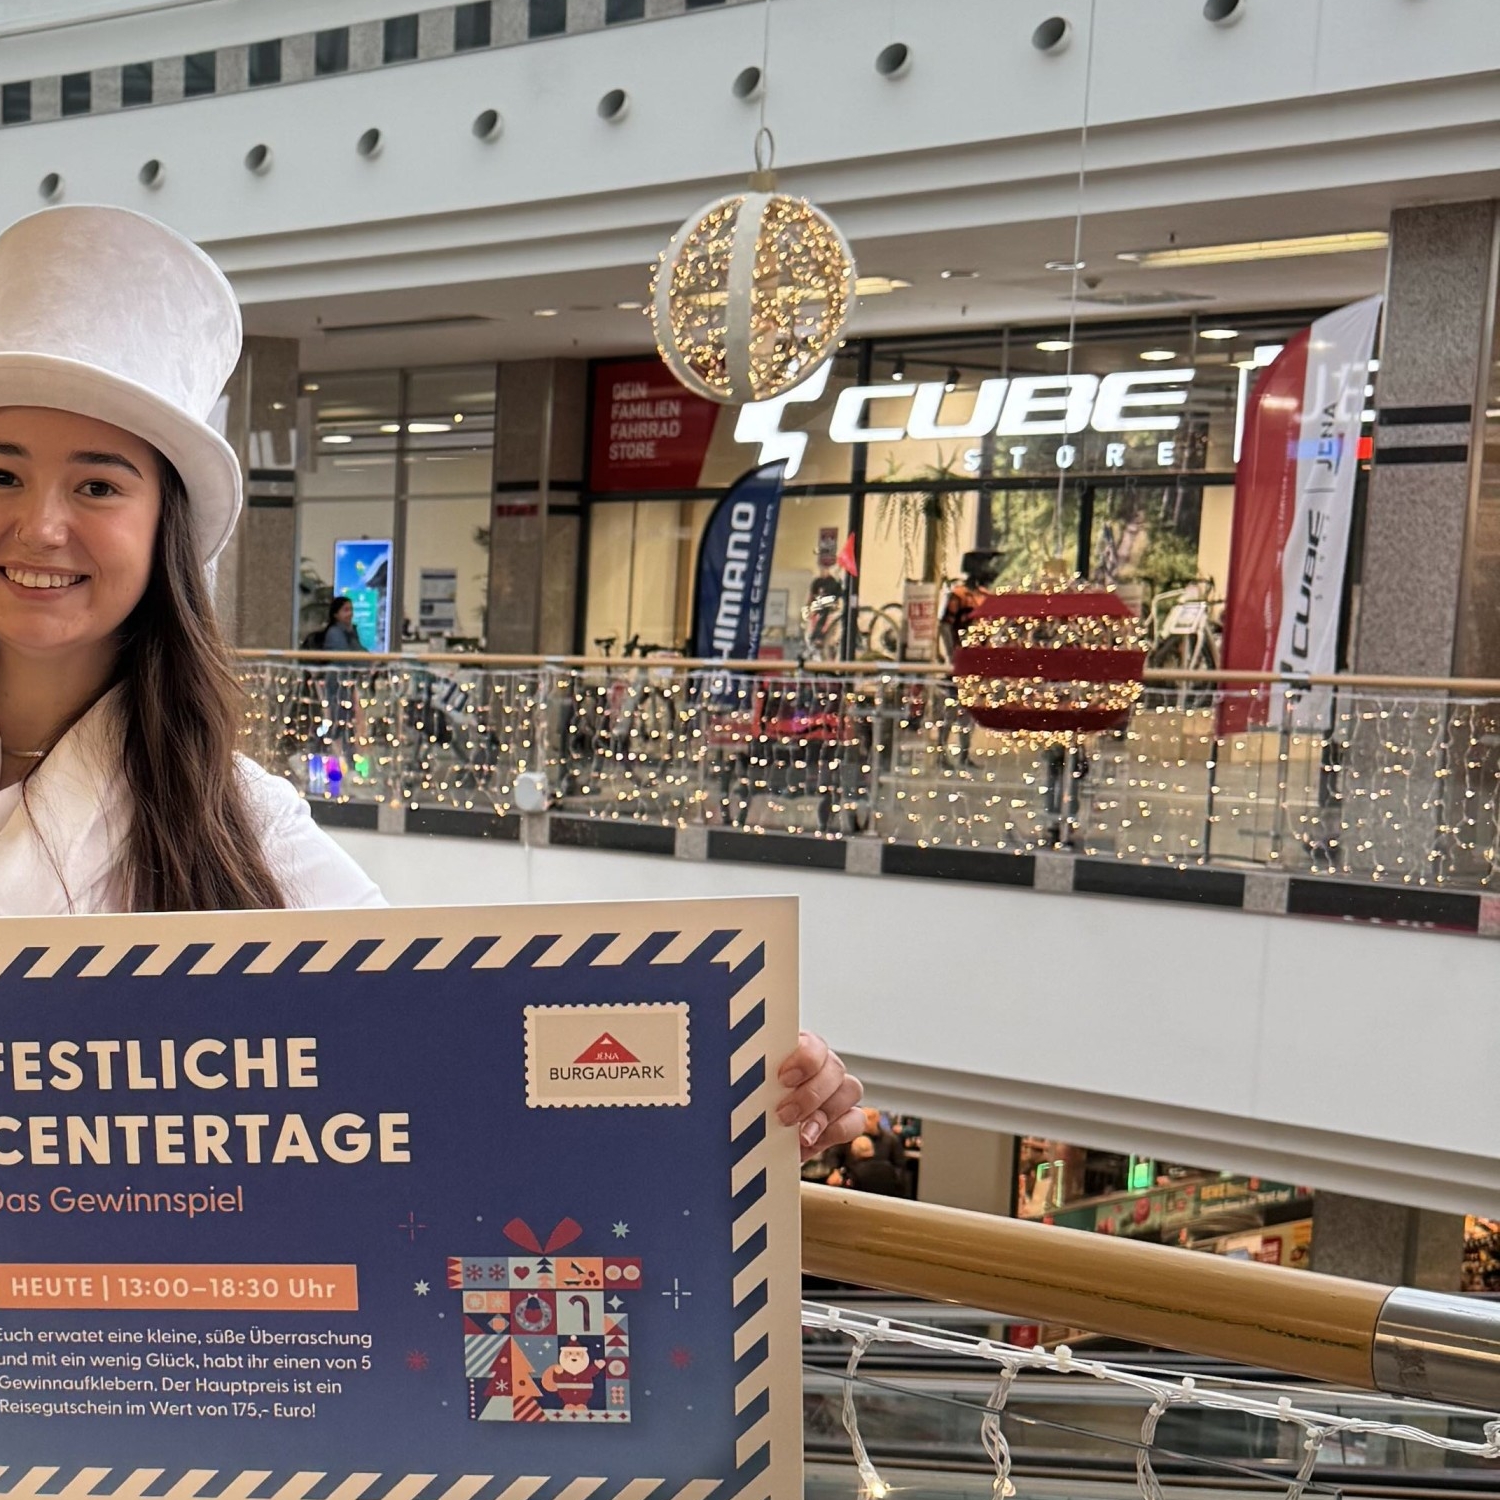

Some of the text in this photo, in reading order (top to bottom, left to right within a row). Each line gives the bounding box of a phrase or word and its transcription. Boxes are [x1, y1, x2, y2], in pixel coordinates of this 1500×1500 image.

[613, 383, 647, 400] DEIN
[611, 401, 681, 420] FAMILIEN
[828, 368, 1196, 443] CUBE
[610, 420, 680, 439] FAHRRAD
[609, 441, 655, 460] STORE
[962, 441, 1177, 473] STORE
[1290, 402, 1340, 659] CUBE JENA
[594, 1052, 619, 1061] JENA
[549, 1065, 665, 1081] BURGAUPARK
[50, 1186, 243, 1218] Gewinnspiel
[11, 1277, 93, 1297] HEUTE
[289, 1278, 336, 1298] Uhr
[38, 1330, 103, 1342] erwatet
[108, 1332, 143, 1342] eine
[148, 1329, 201, 1344] kleine,
[206, 1328, 245, 1344] süße
[250, 1326, 372, 1349] Überraschung
[32, 1354, 56, 1366] mit
[61, 1356, 85, 1366] ein
[90, 1353, 141, 1372] wenig
[146, 1351, 199, 1369] Glück,
[204, 1354, 243, 1368] habt
[248, 1354, 268, 1368] ihr
[274, 1358, 320, 1368] einen
[325, 1359, 356, 1369] von
[362, 1356, 371, 1369] 5
[162, 1377, 190, 1391] Der
[196, 1378, 289, 1395] Hauptpreis
[294, 1379, 311, 1393] ist
[317, 1383, 341, 1393] ein
[0, 1399, 122, 1416] Reisegutschein
[127, 1405, 145, 1414] im
[150, 1402, 192, 1415] Wert
[197, 1405, 227, 1415] von
[274, 1403, 315, 1417] Euro!
